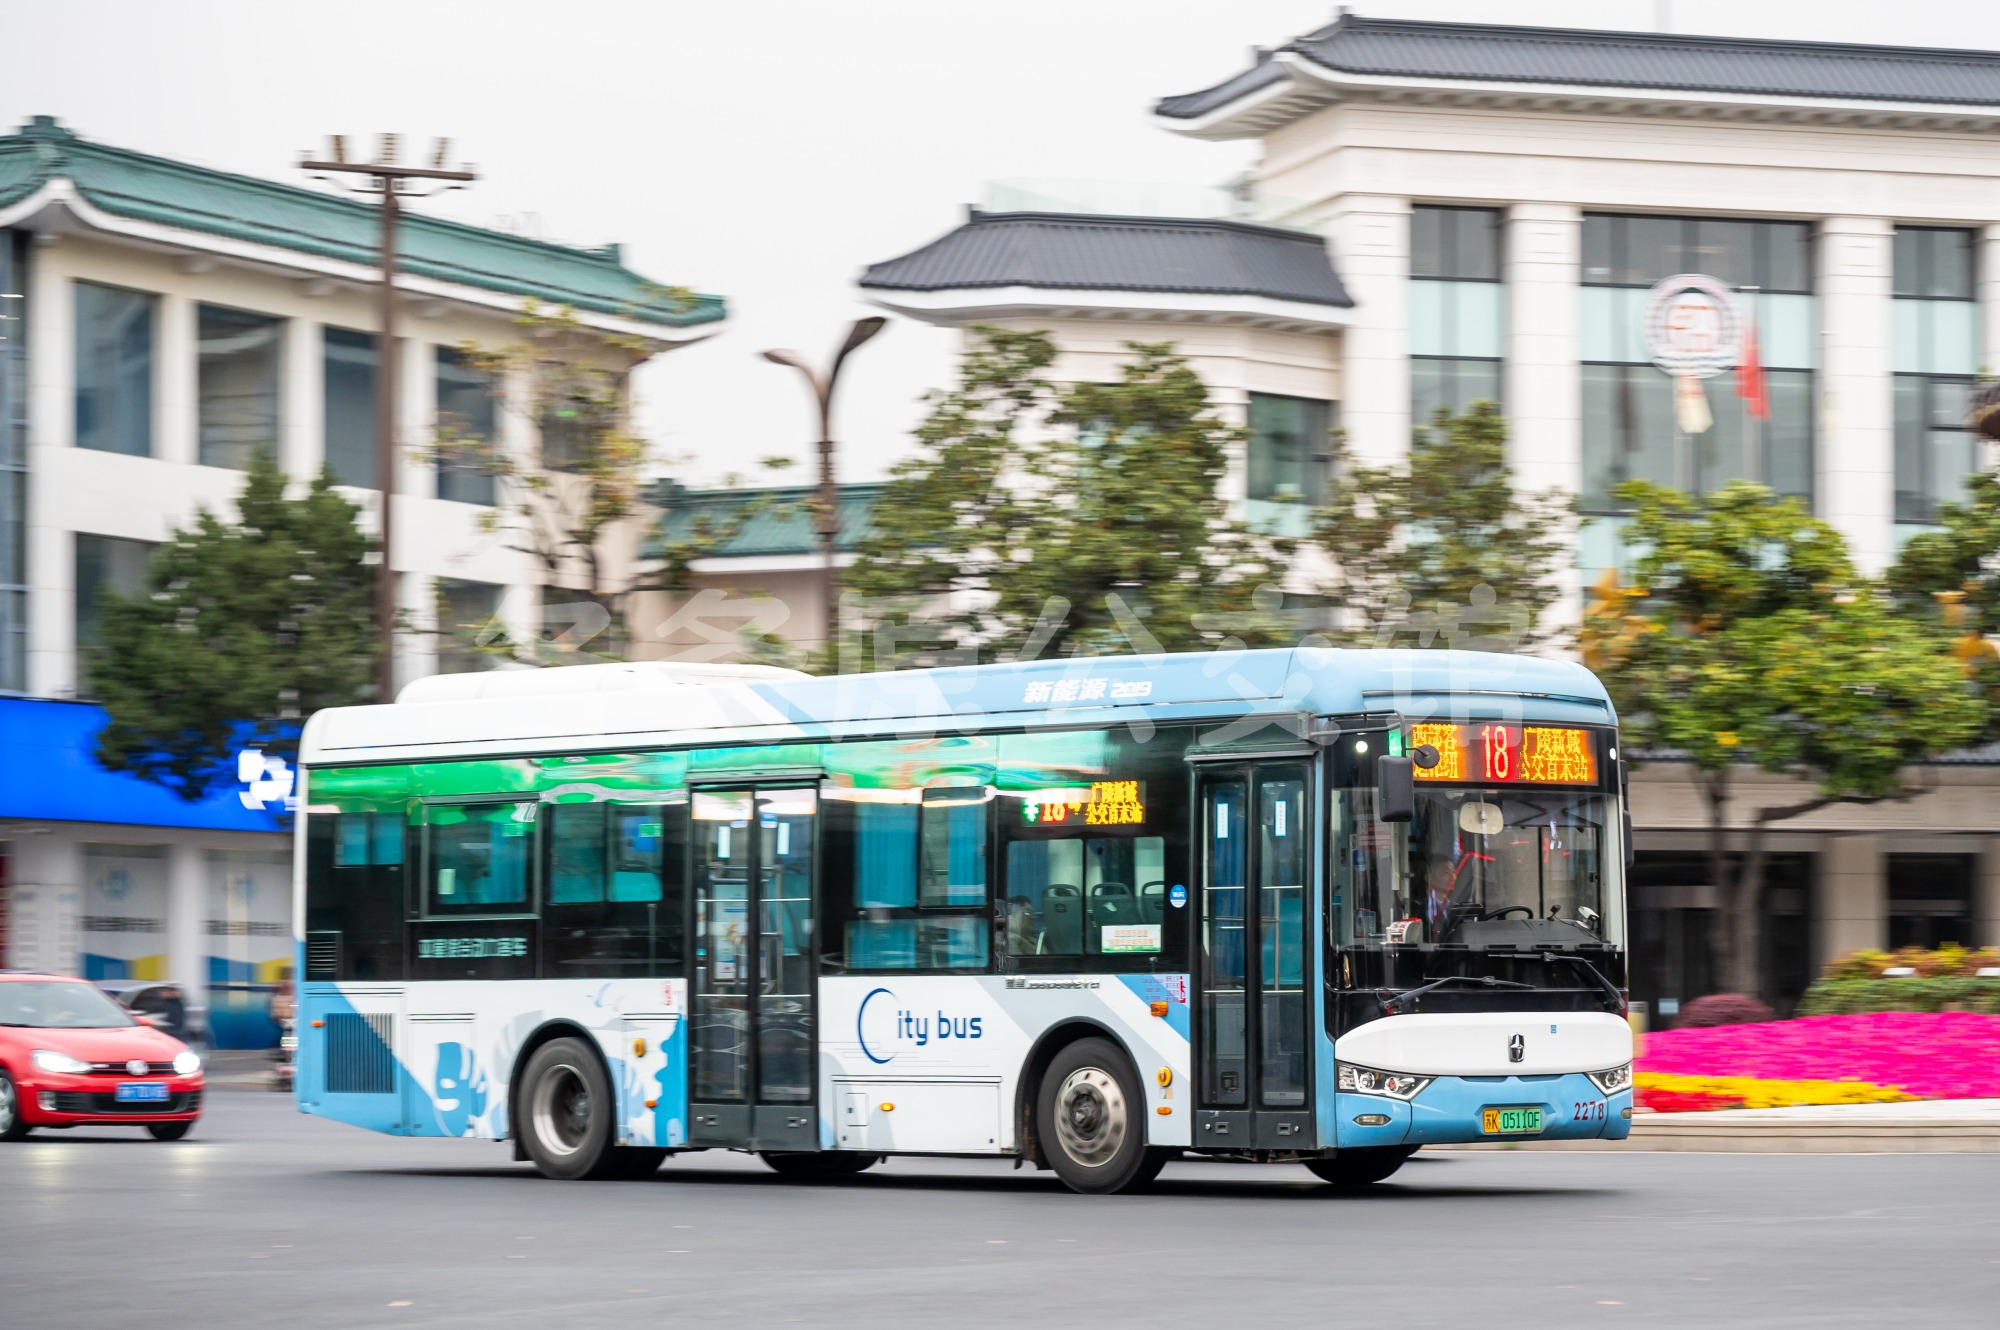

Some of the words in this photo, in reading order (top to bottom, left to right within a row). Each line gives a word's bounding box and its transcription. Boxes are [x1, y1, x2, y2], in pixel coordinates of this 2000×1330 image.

[1022, 678, 1109, 703] 新能源
[1110, 680, 1152, 698] 2019
[1481, 726, 1508, 779] 18
[1516, 752, 1588, 782] 公交首末站
[858, 987, 927, 1065] City
[938, 1010, 983, 1040] bus
[1573, 1101, 1605, 1121] 2278
